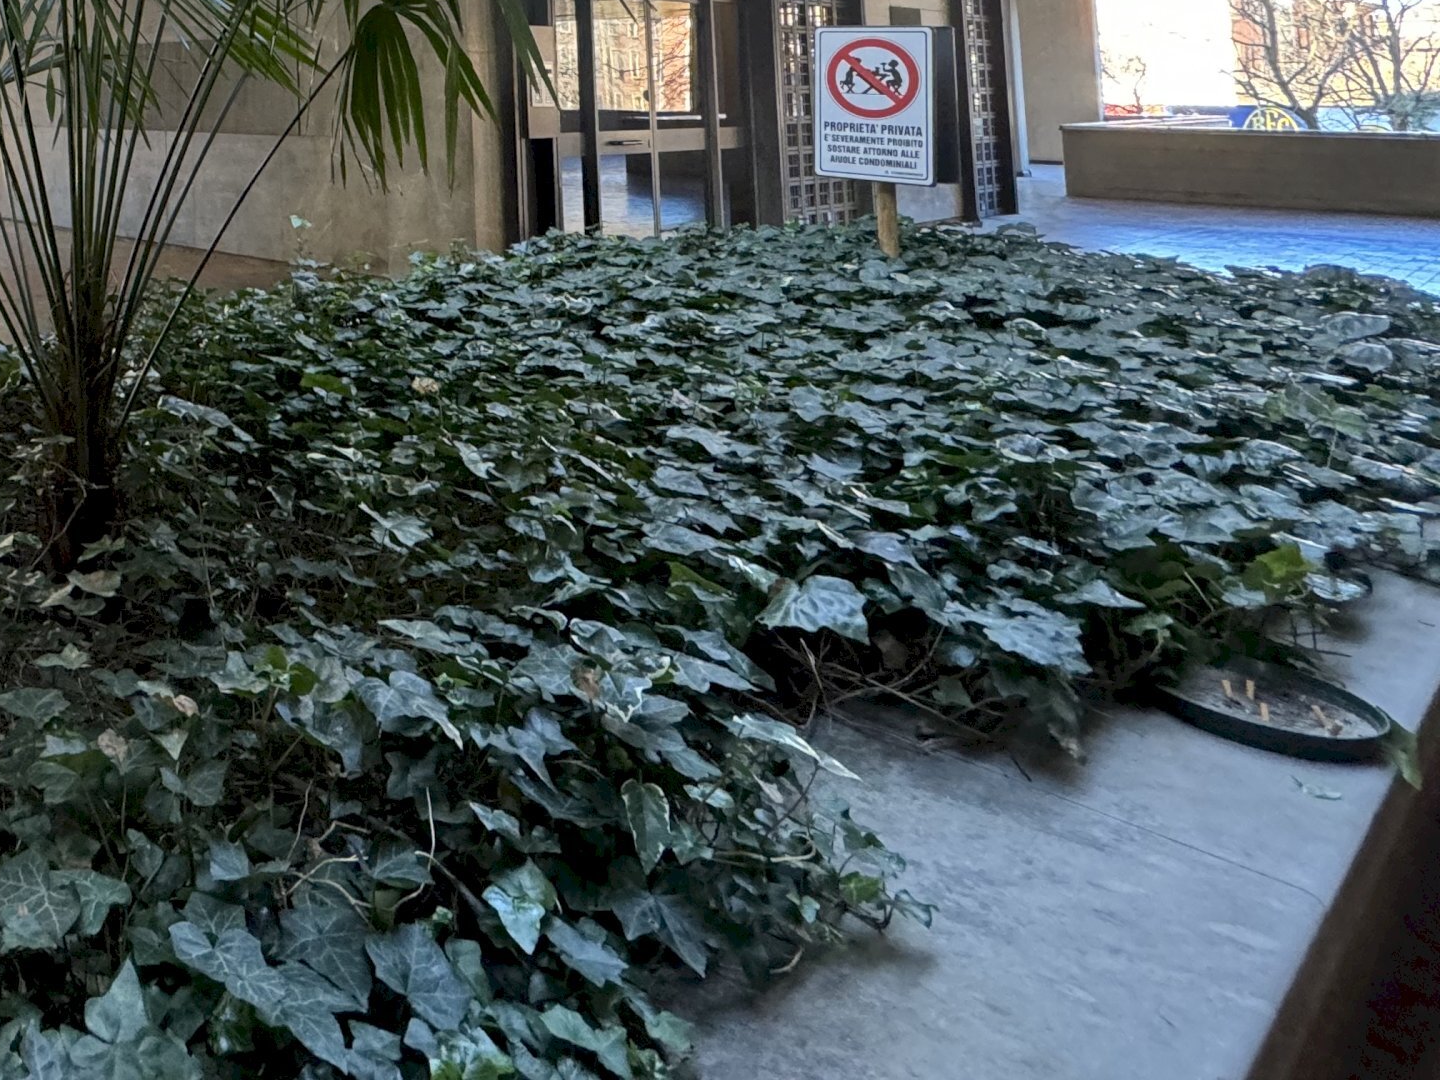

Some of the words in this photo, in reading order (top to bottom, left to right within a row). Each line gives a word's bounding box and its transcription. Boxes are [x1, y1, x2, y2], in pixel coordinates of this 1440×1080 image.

[823, 121, 879, 134] PROPRIETA'
[881, 124, 923, 137] PRIVATA
[831, 134, 885, 145] SEVERAMENTE
[887, 138, 923, 148] PROIBITO
[827, 144, 861, 154] SOSTARE
[863, 147, 898, 157] ATTORNO
[900, 149, 920, 159] ALLE
[830, 155, 856, 164] AIUOLE
[858, 157, 917, 169] CONDOMINIALI
